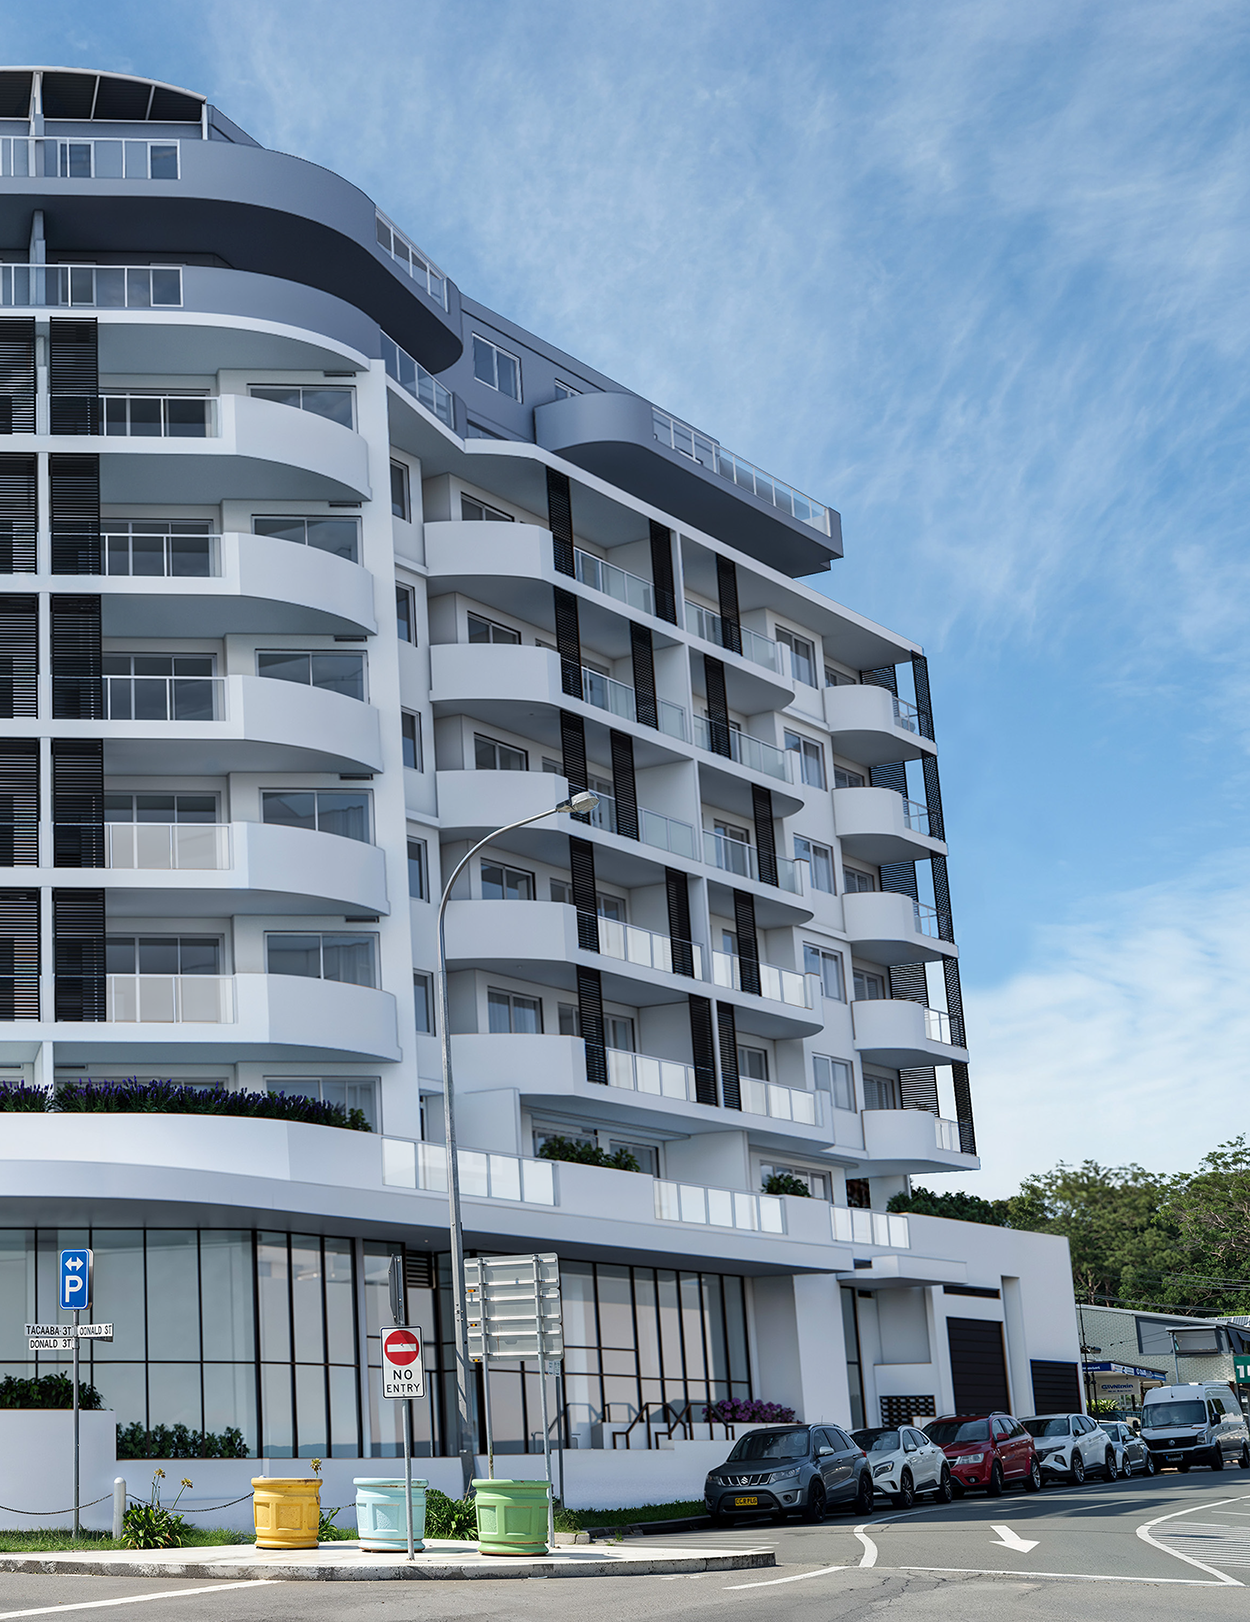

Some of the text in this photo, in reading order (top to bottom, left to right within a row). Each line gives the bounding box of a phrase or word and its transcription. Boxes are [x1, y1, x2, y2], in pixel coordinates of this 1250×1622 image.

[65, 1275, 83, 1302] P
[30, 1339, 58, 1348] DONALD
[393, 1369, 413, 1380] NO
[386, 1383, 420, 1393] ENTRY
